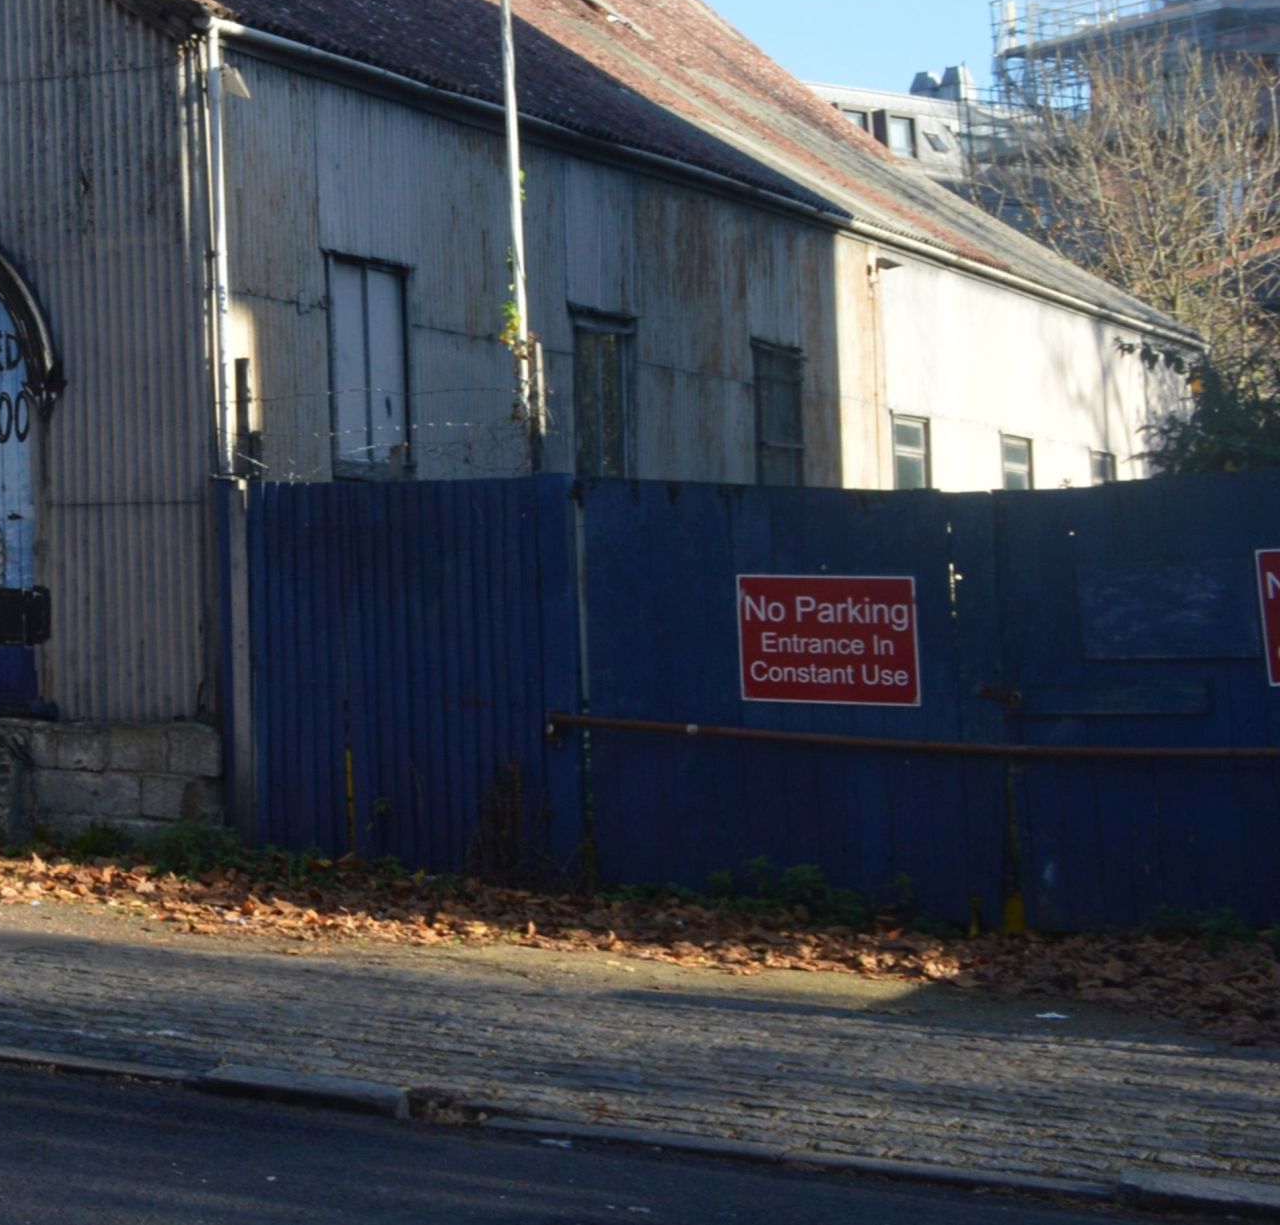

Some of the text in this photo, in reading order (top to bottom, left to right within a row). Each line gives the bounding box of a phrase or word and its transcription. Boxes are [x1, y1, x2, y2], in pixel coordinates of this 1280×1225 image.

[744, 595, 910, 632] No Parking
[761, 632, 895, 656] Entrance In
[750, 660, 909, 686] Constant Use
